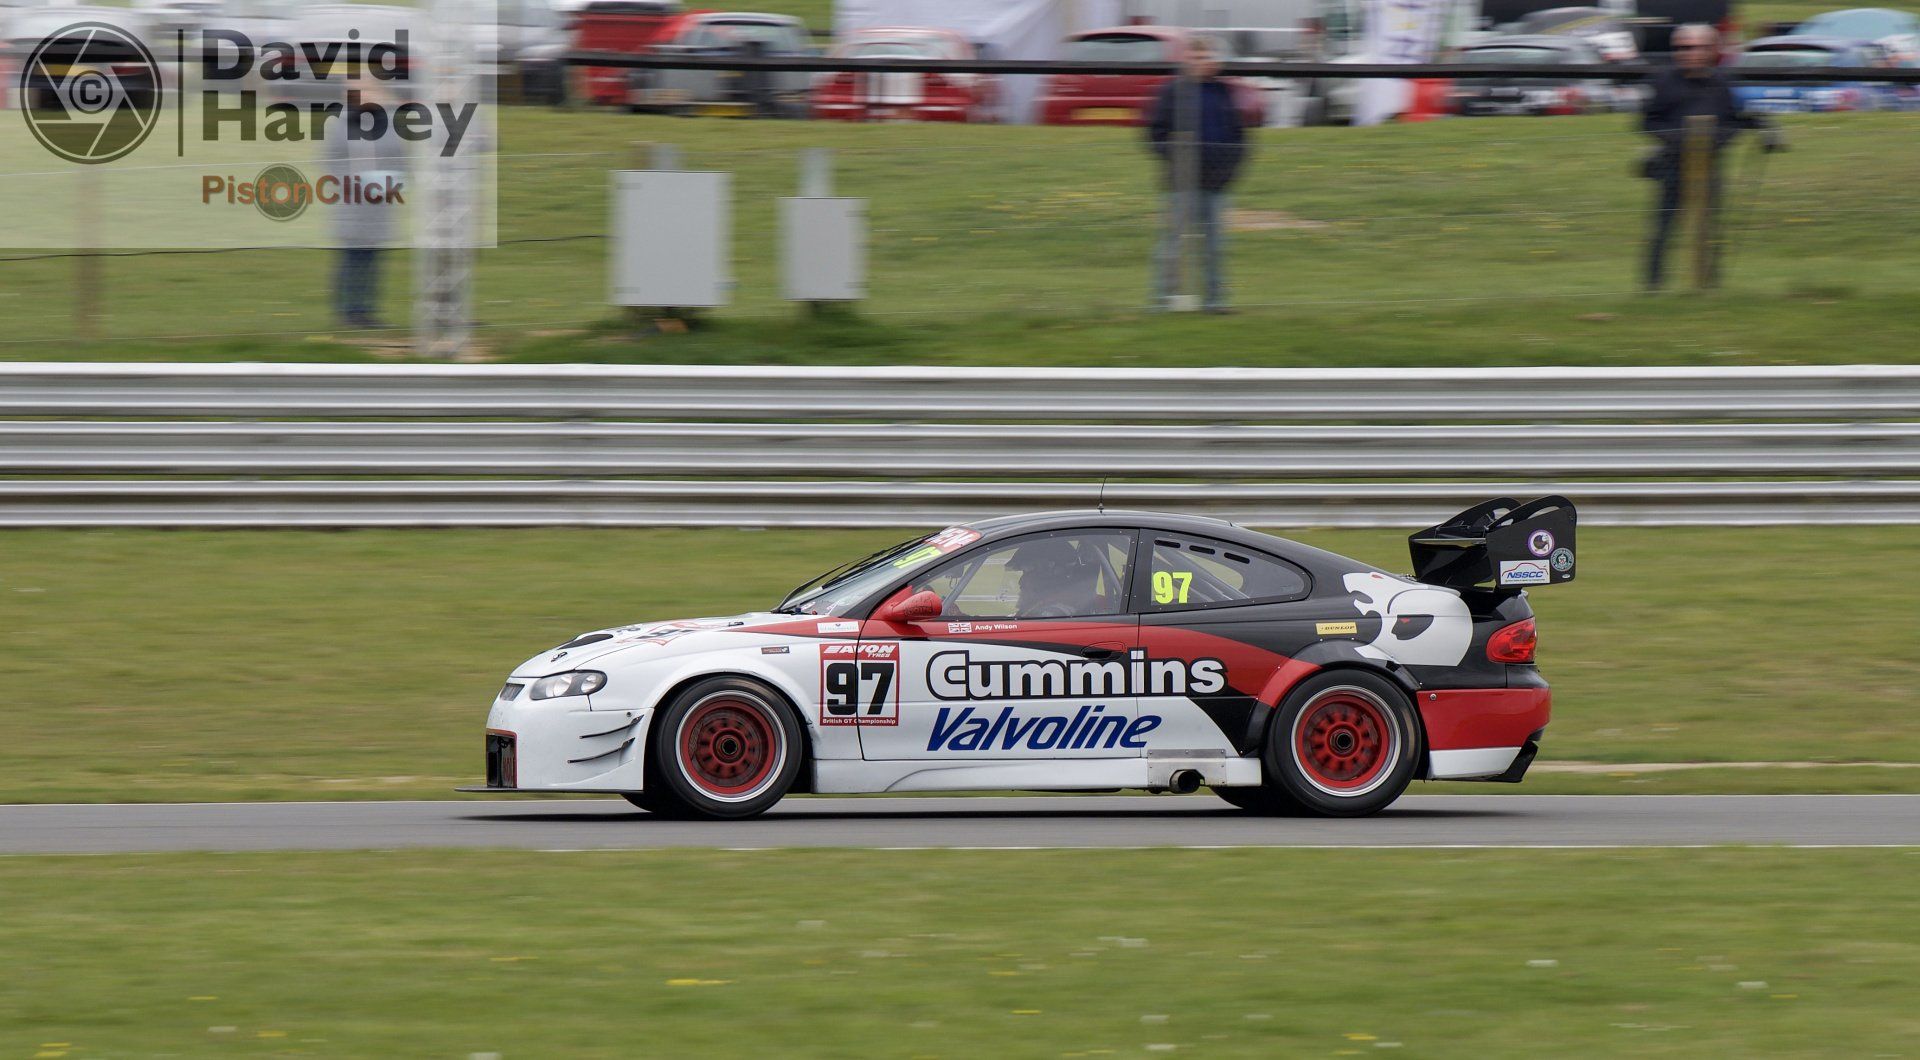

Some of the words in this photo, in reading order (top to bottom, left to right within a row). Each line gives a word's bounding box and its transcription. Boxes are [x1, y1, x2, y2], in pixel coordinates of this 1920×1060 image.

[1153, 571, 1193, 604] 97
[1507, 571, 1544, 579] NSSCC
[838, 644, 897, 654] AVON
[826, 663, 895, 715] 97
[926, 648, 1228, 700] Cummins
[926, 705, 1162, 750] Valvoline
